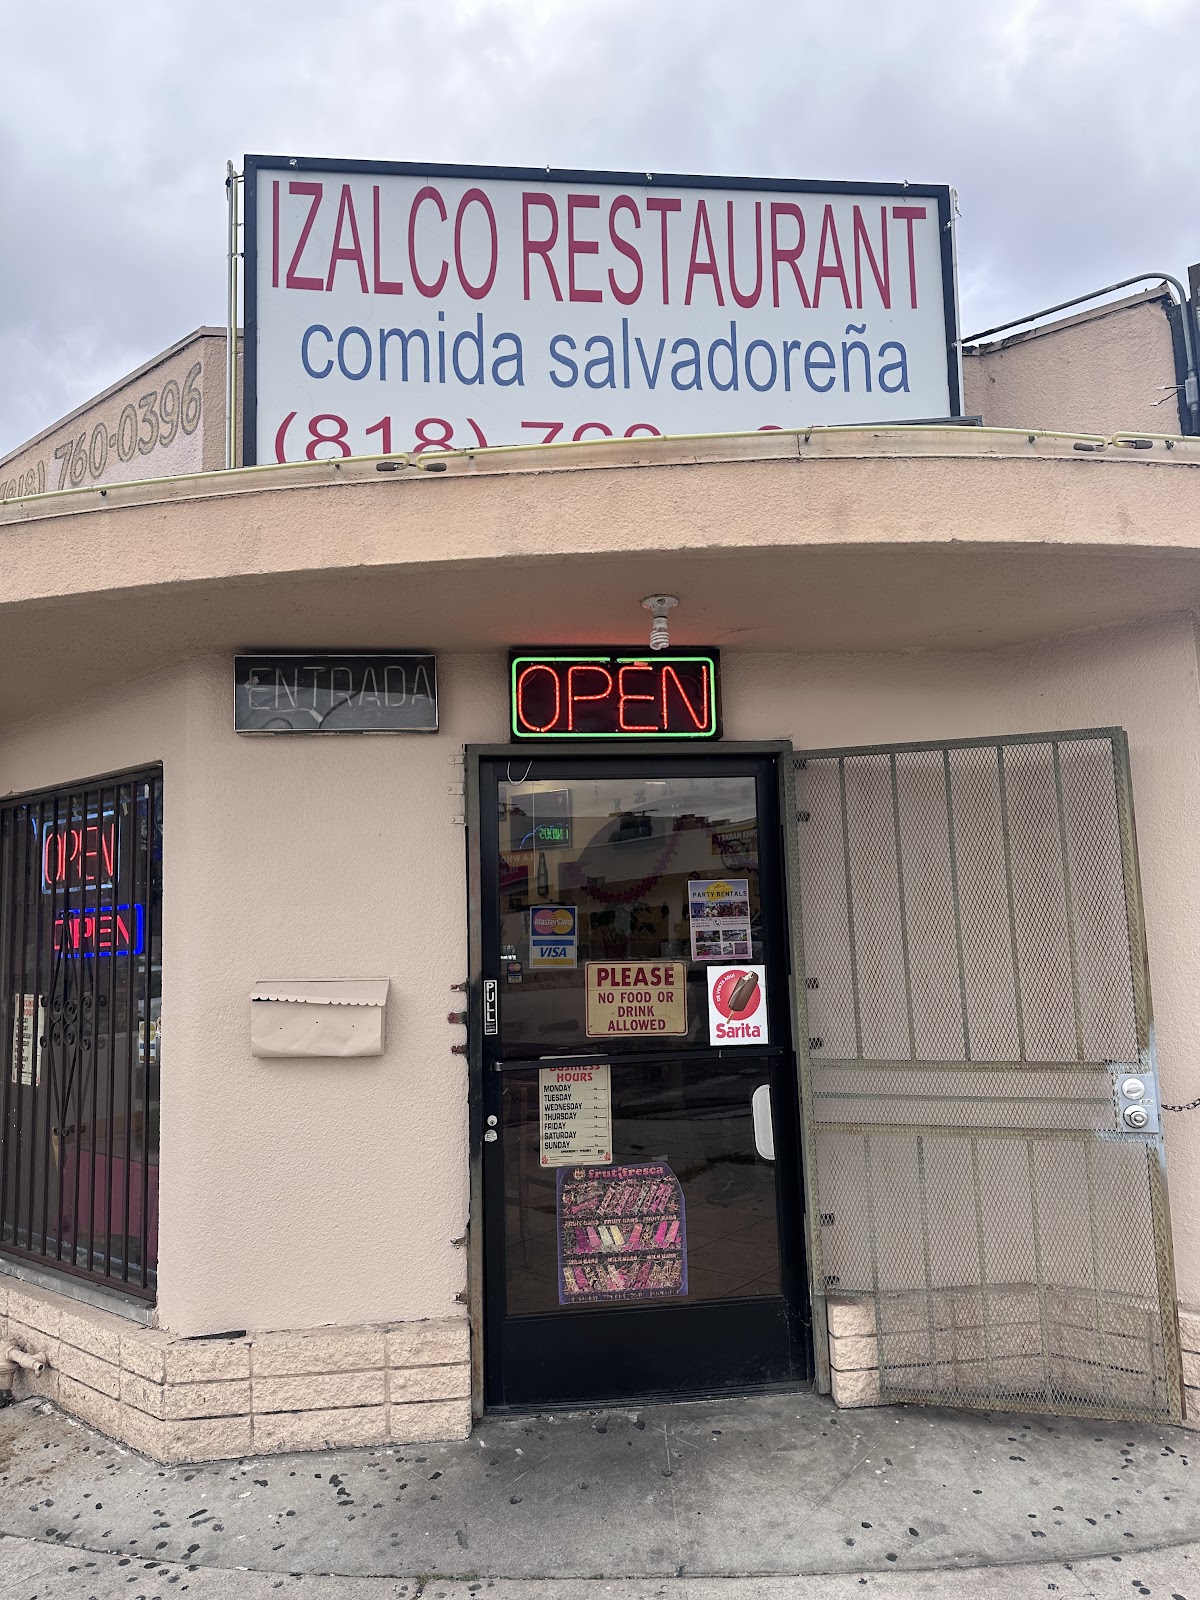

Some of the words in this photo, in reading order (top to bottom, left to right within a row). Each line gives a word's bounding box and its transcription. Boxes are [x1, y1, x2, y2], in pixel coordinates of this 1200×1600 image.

[272, 180, 498, 300] IZALCO
[522, 191, 927, 310] RESTAURANT
[301, 310, 525, 387] comida
[548, 317, 911, 393] salvadoreña
[54, 361, 202, 491] 760-0396
[247, 664, 435, 710] ENTRADA
[517, 664, 708, 732] OPEN
[44, 822, 115, 884] OPEN
[534, 918, 573, 926] MasterCard
[54, 914, 130, 951] OPEN
[539, 946, 567, 958] VISA
[597, 967, 675, 987] PLEASE
[486, 982, 495, 1021] PULL
[598, 992, 614, 1004] NO
[620, 991, 652, 1003] FOOD
[657, 991, 674, 1002] OR
[617, 1005, 655, 1017] DRINK
[608, 1018, 666, 1031] ALLOWED
[716, 1022, 761, 1039] Sarita
[556, 1072, 593, 1082] HOURS
[544, 1084, 572, 1092] MONDAY
[544, 1094, 572, 1102] TUESDAY
[545, 1103, 583, 1111] WEDNESDAY
[545, 1112, 577, 1121] THURSDAY
[544, 1122, 566, 1130] FRIDAY
[544, 1131, 577, 1140] SATURDAY
[544, 1141, 570, 1150] SUNDAY
[587, 1166, 664, 1179] frutifresca
